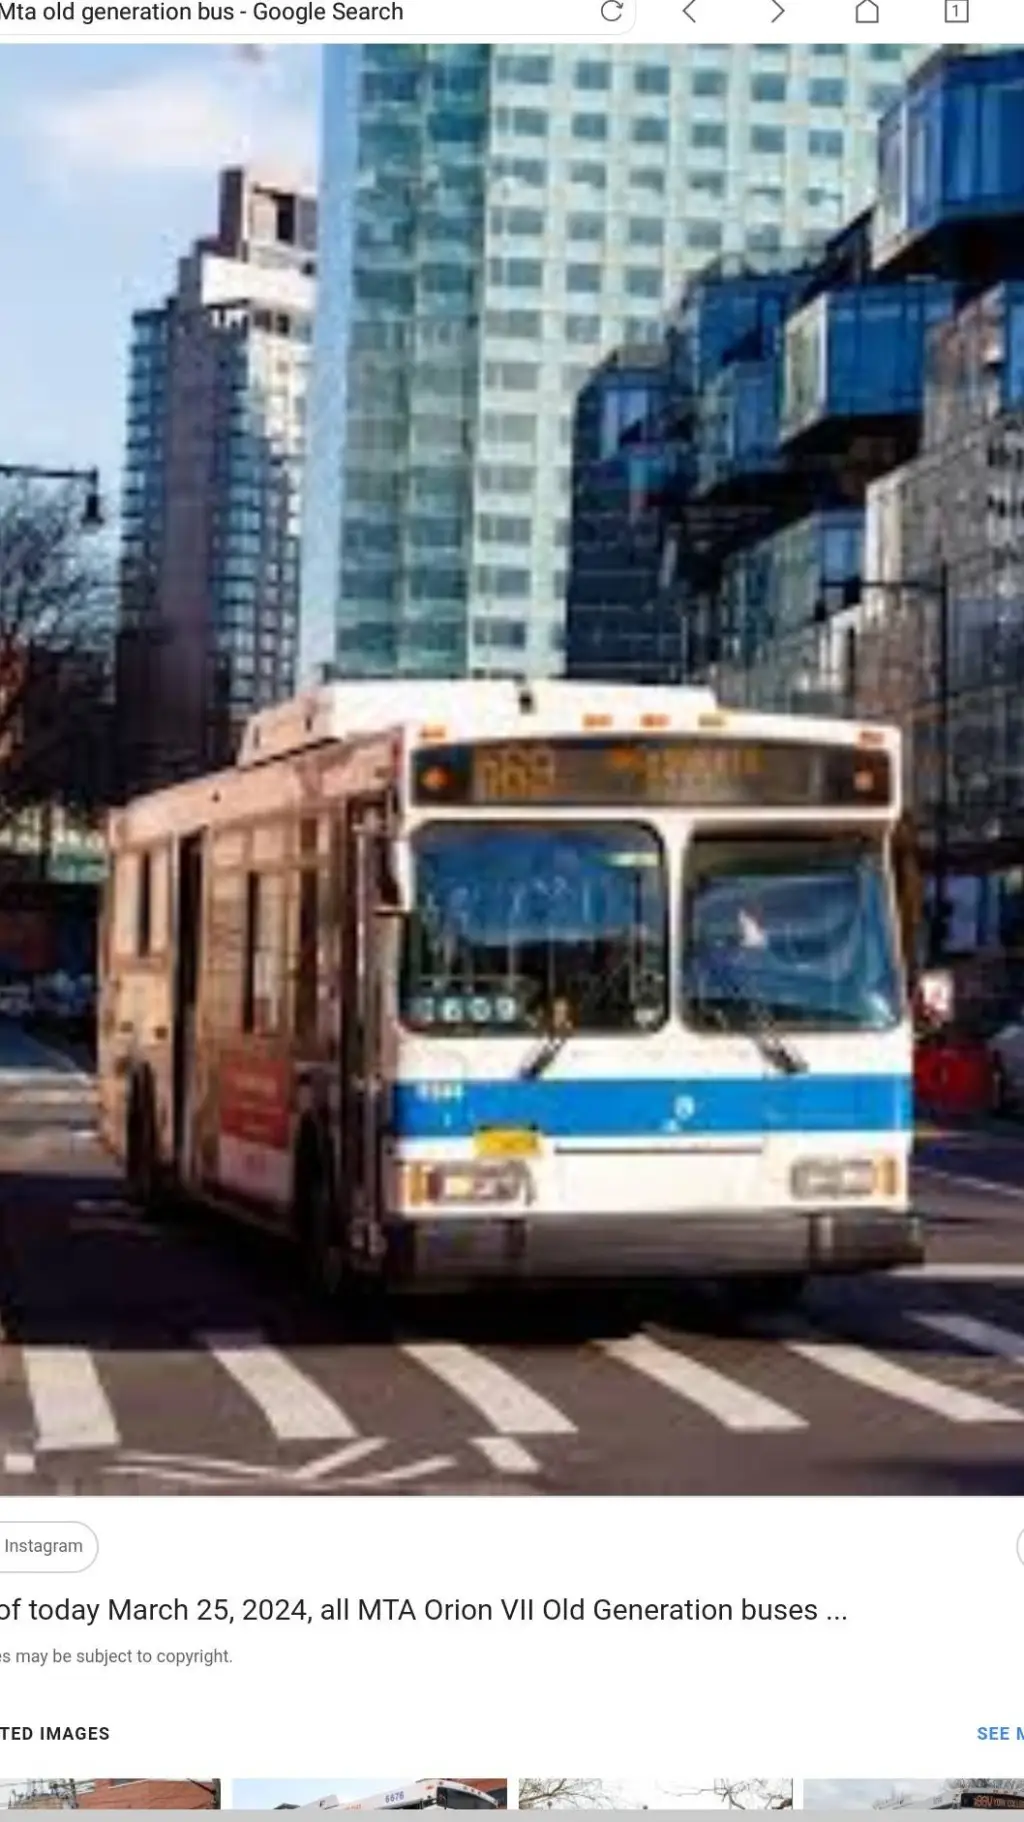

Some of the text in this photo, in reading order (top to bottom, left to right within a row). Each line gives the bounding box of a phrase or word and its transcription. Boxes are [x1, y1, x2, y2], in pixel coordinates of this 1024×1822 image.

[0, 2, 36, 20] Mta
[43, 1, 75, 20] old
[82, 2, 191, 25] generation
[198, 1, 234, 20] bus
[253, 1, 326, 25] Google
[333, 1, 404, 20] Search
[5, 1538, 83, 1557] Instagram
[0, 1598, 22, 1621] of
[28, 1598, 100, 1626] today
[109, 1598, 188, 1621] March
[197, 1599, 234, 1625] 25,
[243, 1599, 312, 1625] 2024,
[321, 1598, 349, 1621] all
[359, 1599, 416, 1621] MTA
[425, 1599, 492, 1621] Orion
[501, 1599, 533, 1621] VII
[543, 1598, 584, 1621] Old
[594, 1599, 732, 1621] Generation
[742, 1598, 817, 1621] buses
[16, 1652, 48, 1667] may
[53, 1648, 72, 1663] be
[76, 1648, 132, 1667] subject
[136, 1650, 152, 1663] to
[156, 1648, 233, 1668] copyright.
[0, 1726, 110, 1741] TED IMAGES
[977, 1726, 1010, 1741] SEE
